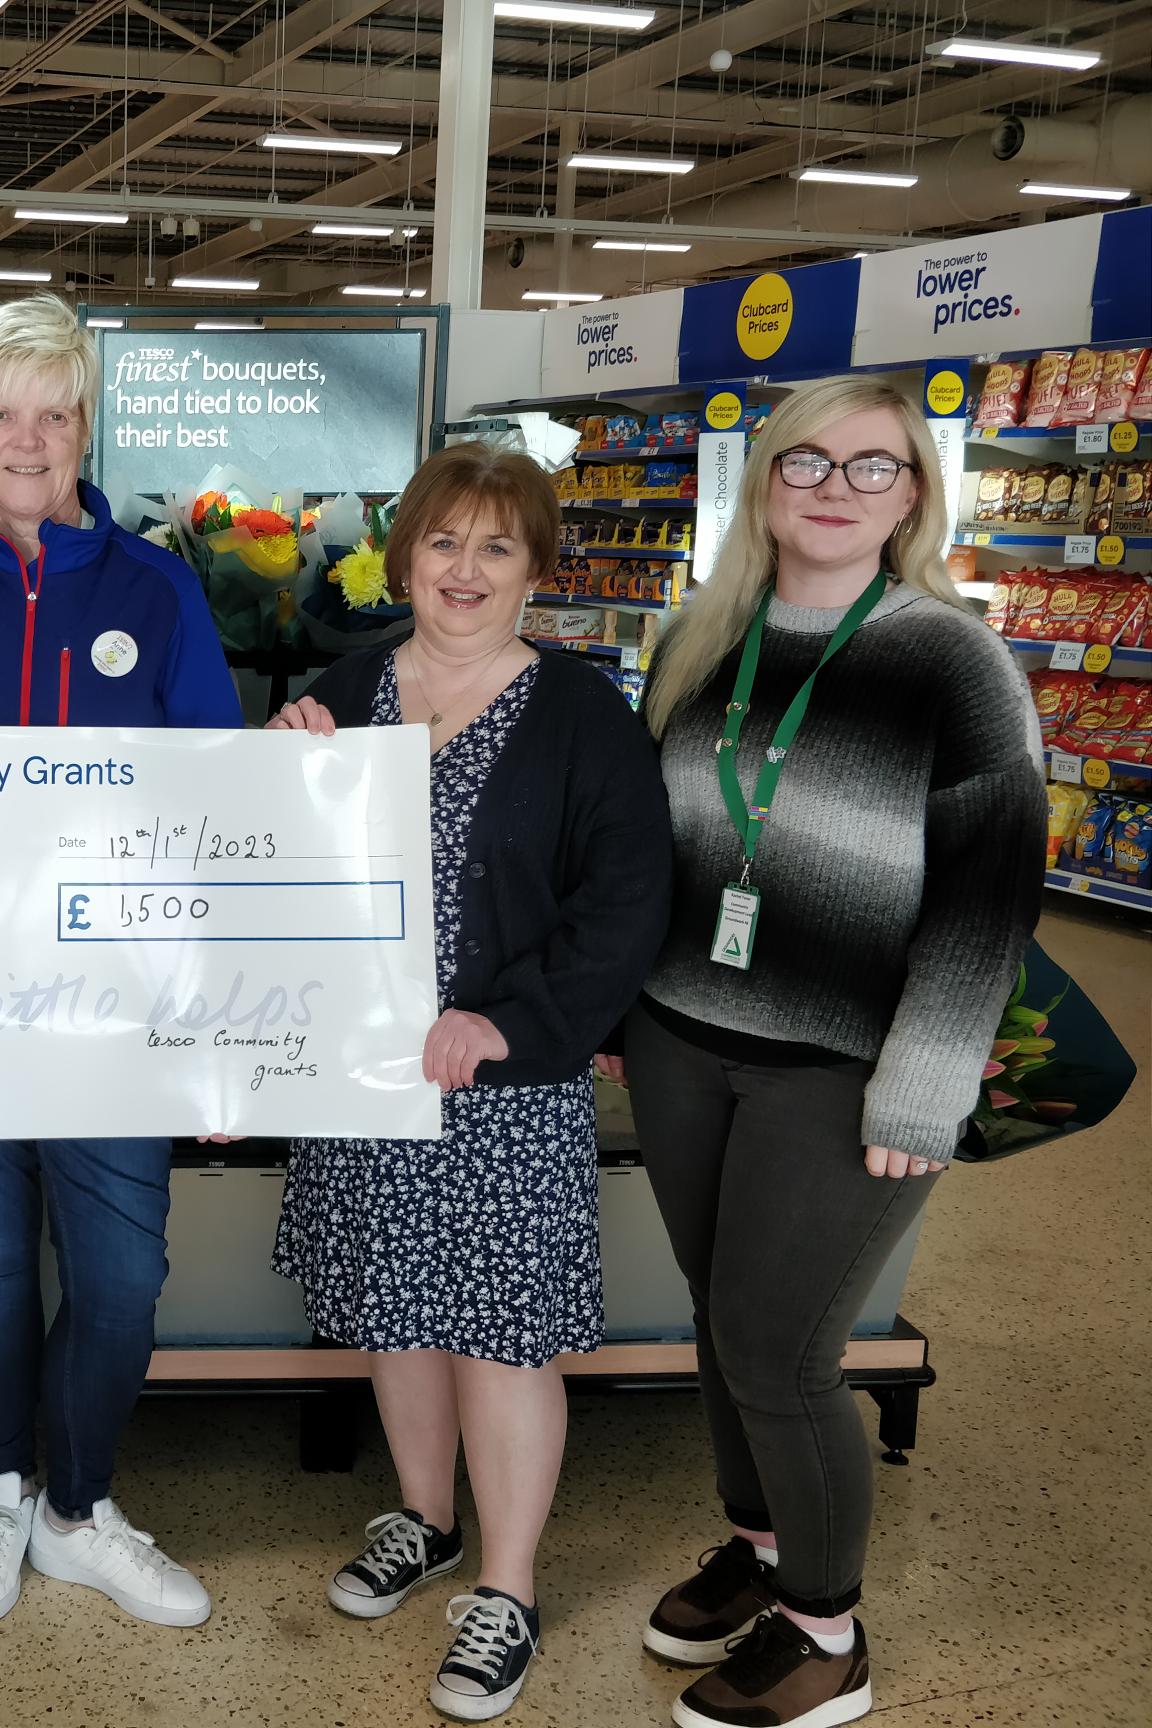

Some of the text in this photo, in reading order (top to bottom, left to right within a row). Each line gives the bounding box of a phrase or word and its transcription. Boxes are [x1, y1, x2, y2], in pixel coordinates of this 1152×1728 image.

[924, 251, 988, 271] The power to
[916, 266, 987, 299] lower
[581, 311, 619, 325] The power to
[741, 299, 789, 319] Clubcard
[933, 293, 1021, 334] prices.
[576, 322, 619, 345] lower
[747, 319, 779, 335] Prices
[138, 348, 175, 357] TESCO
[587, 343, 638, 373] prices.
[202, 355, 326, 387] bouquets,
[930, 386, 961, 394] Clubcard
[934, 394, 955, 402] Prices
[116, 388, 321, 415] hand tied to look
[115, 421, 229, 448] their best
[1083, 434, 1102, 443] £1.80
[1113, 432, 1133, 440] £1.25
[714, 441, 728, 510] Chocolate
[1071, 545, 1090, 554] £1.75
[1100, 545, 1119, 553] £1.50
[1058, 652, 1078, 661] £1.75
[1087, 652, 1106, 661] £1.50
[22, 755, 135, 787] Grants
[1086, 766, 1105, 775] £1.50
[58, 836, 87, 848] Date
[150, 970, 325, 1038] helps
[251, 1063, 318, 1091] grants
